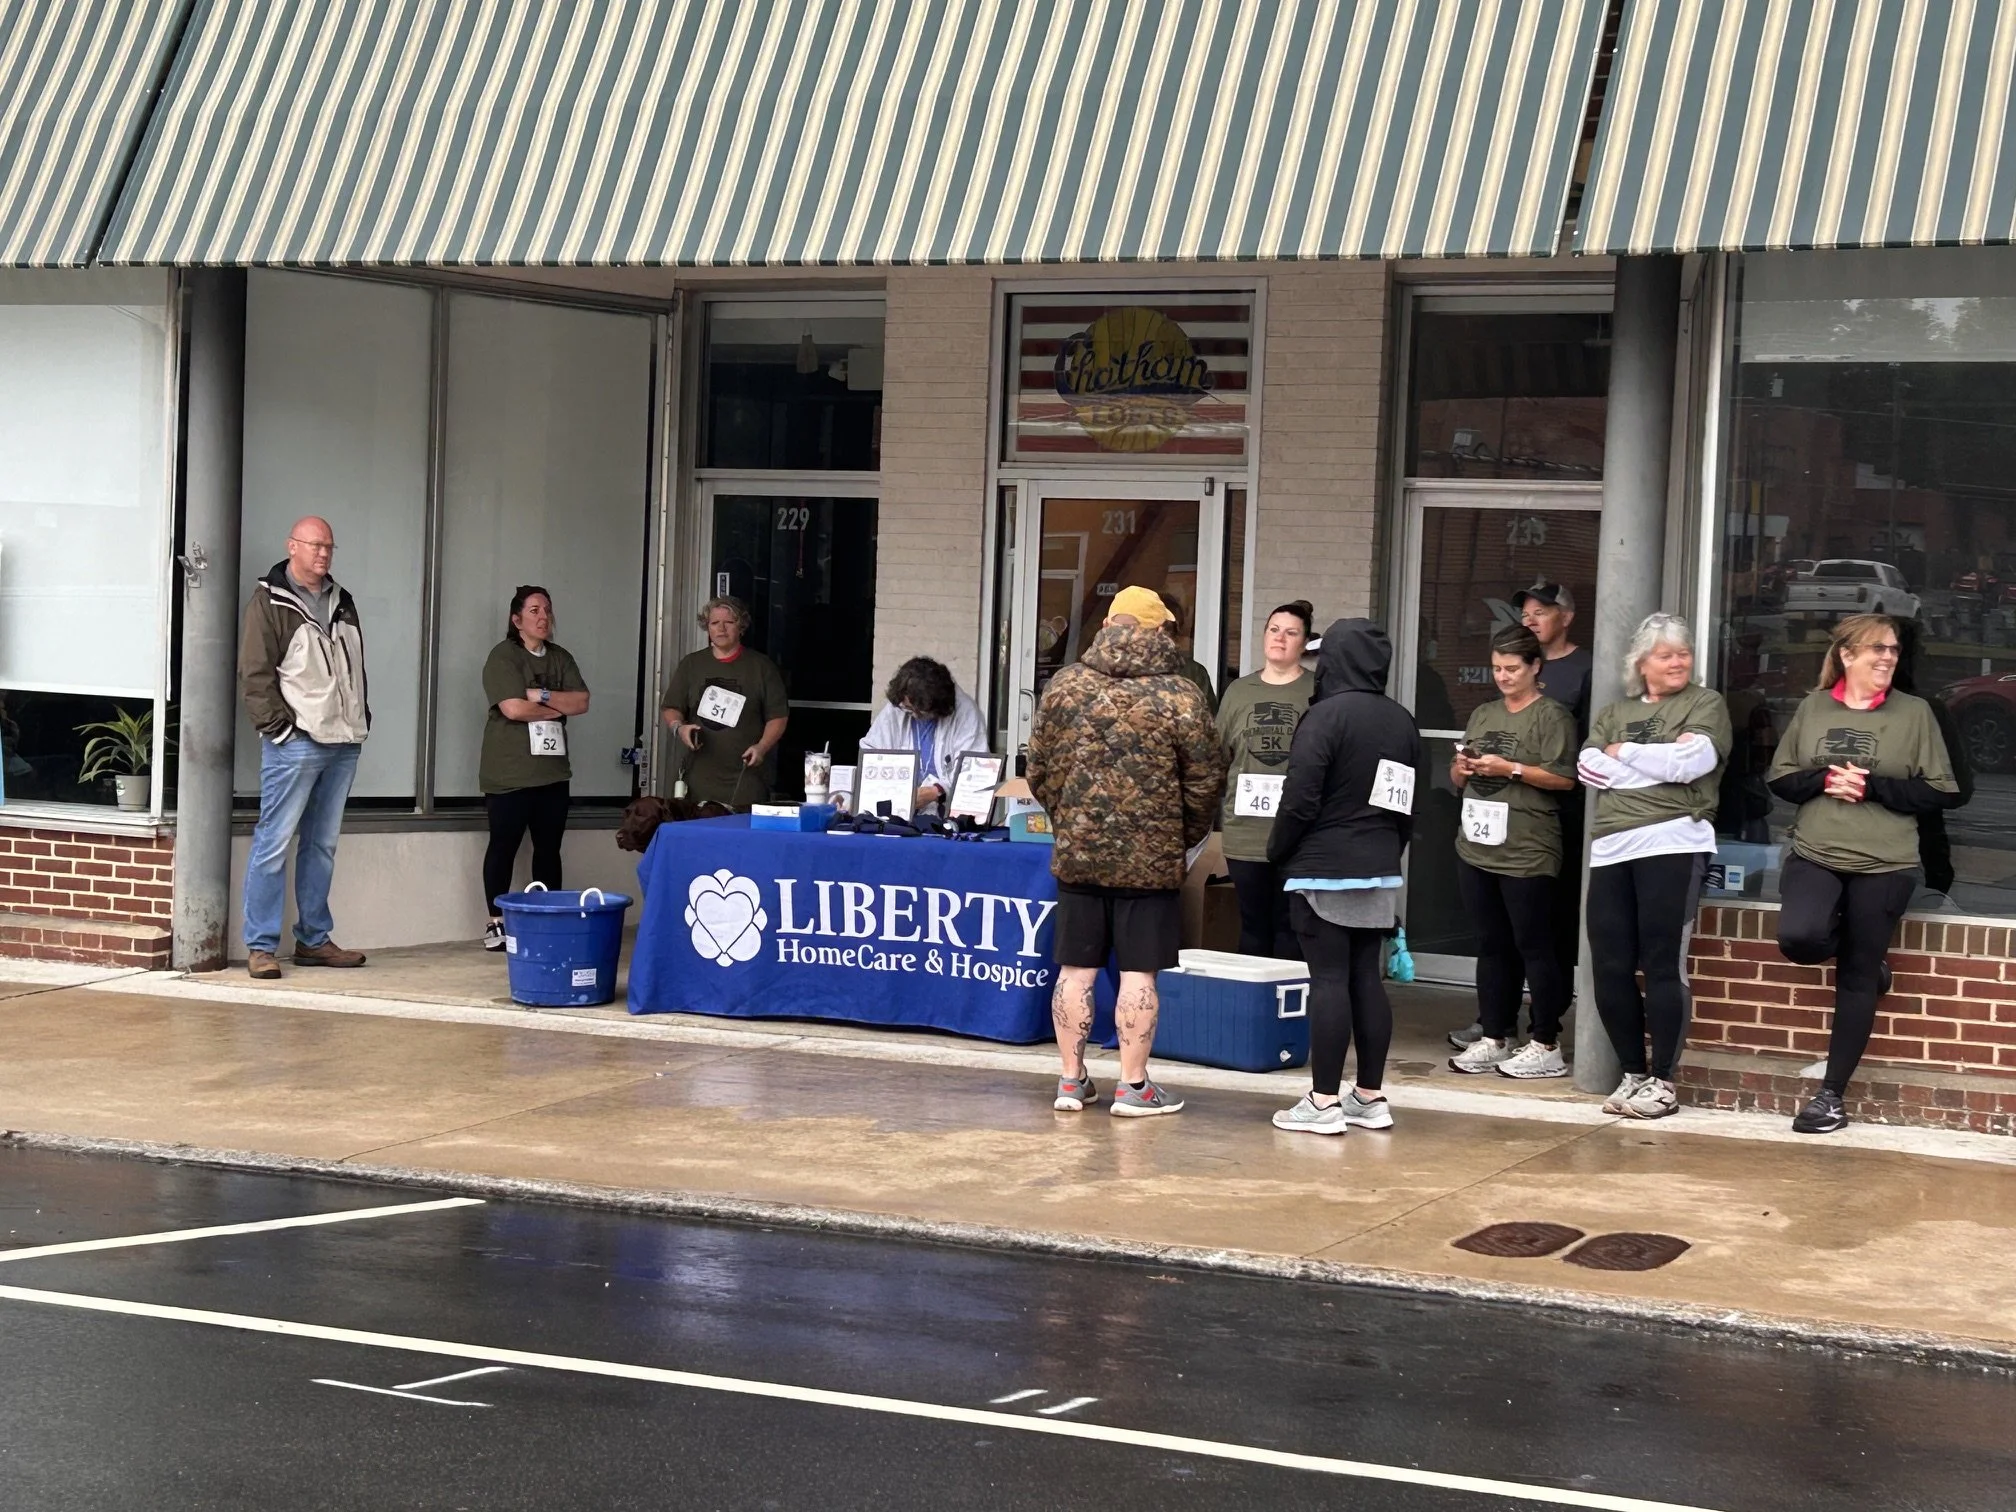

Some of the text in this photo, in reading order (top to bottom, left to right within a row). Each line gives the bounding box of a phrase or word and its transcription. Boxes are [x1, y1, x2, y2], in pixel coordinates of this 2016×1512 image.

[777, 507, 810, 530] 229
[1102, 509, 1137, 535] 231
[711, 704, 727, 719] 51
[543, 738, 557, 751] 52
[1260, 736, 1282, 750] 5K
[1250, 796, 1270, 811] 46
[1387, 786, 1408, 806] 110
[1473, 822, 1490, 839] 24
[774, 878, 1058, 957] LIBERTY
[776, 938, 1050, 991] HomeCare & Hospice
